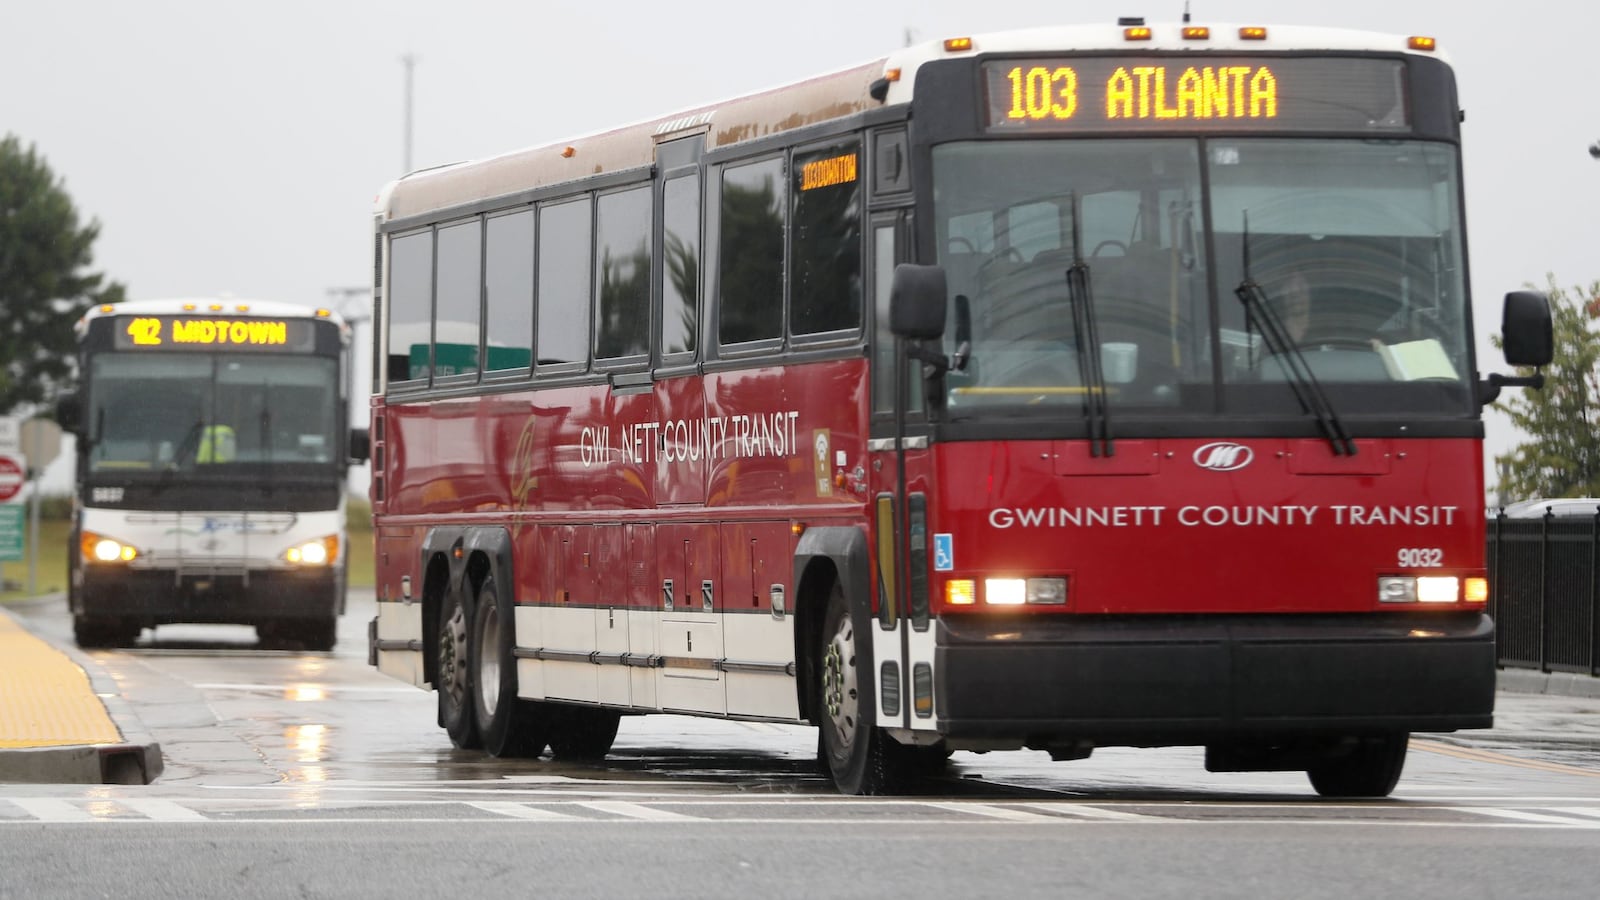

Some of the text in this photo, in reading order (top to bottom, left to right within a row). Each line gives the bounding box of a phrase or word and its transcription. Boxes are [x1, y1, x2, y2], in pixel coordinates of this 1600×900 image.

[1008, 64, 1278, 120] 103 ATLANTA
[172, 319, 287, 345] MIDTOWN
[664, 416, 728, 463] COUNTY
[732, 411, 799, 458] TRANSIT
[989, 504, 1457, 528] GWINNETT COUNTY TRANSIT
[1398, 548, 1443, 568] 9032
